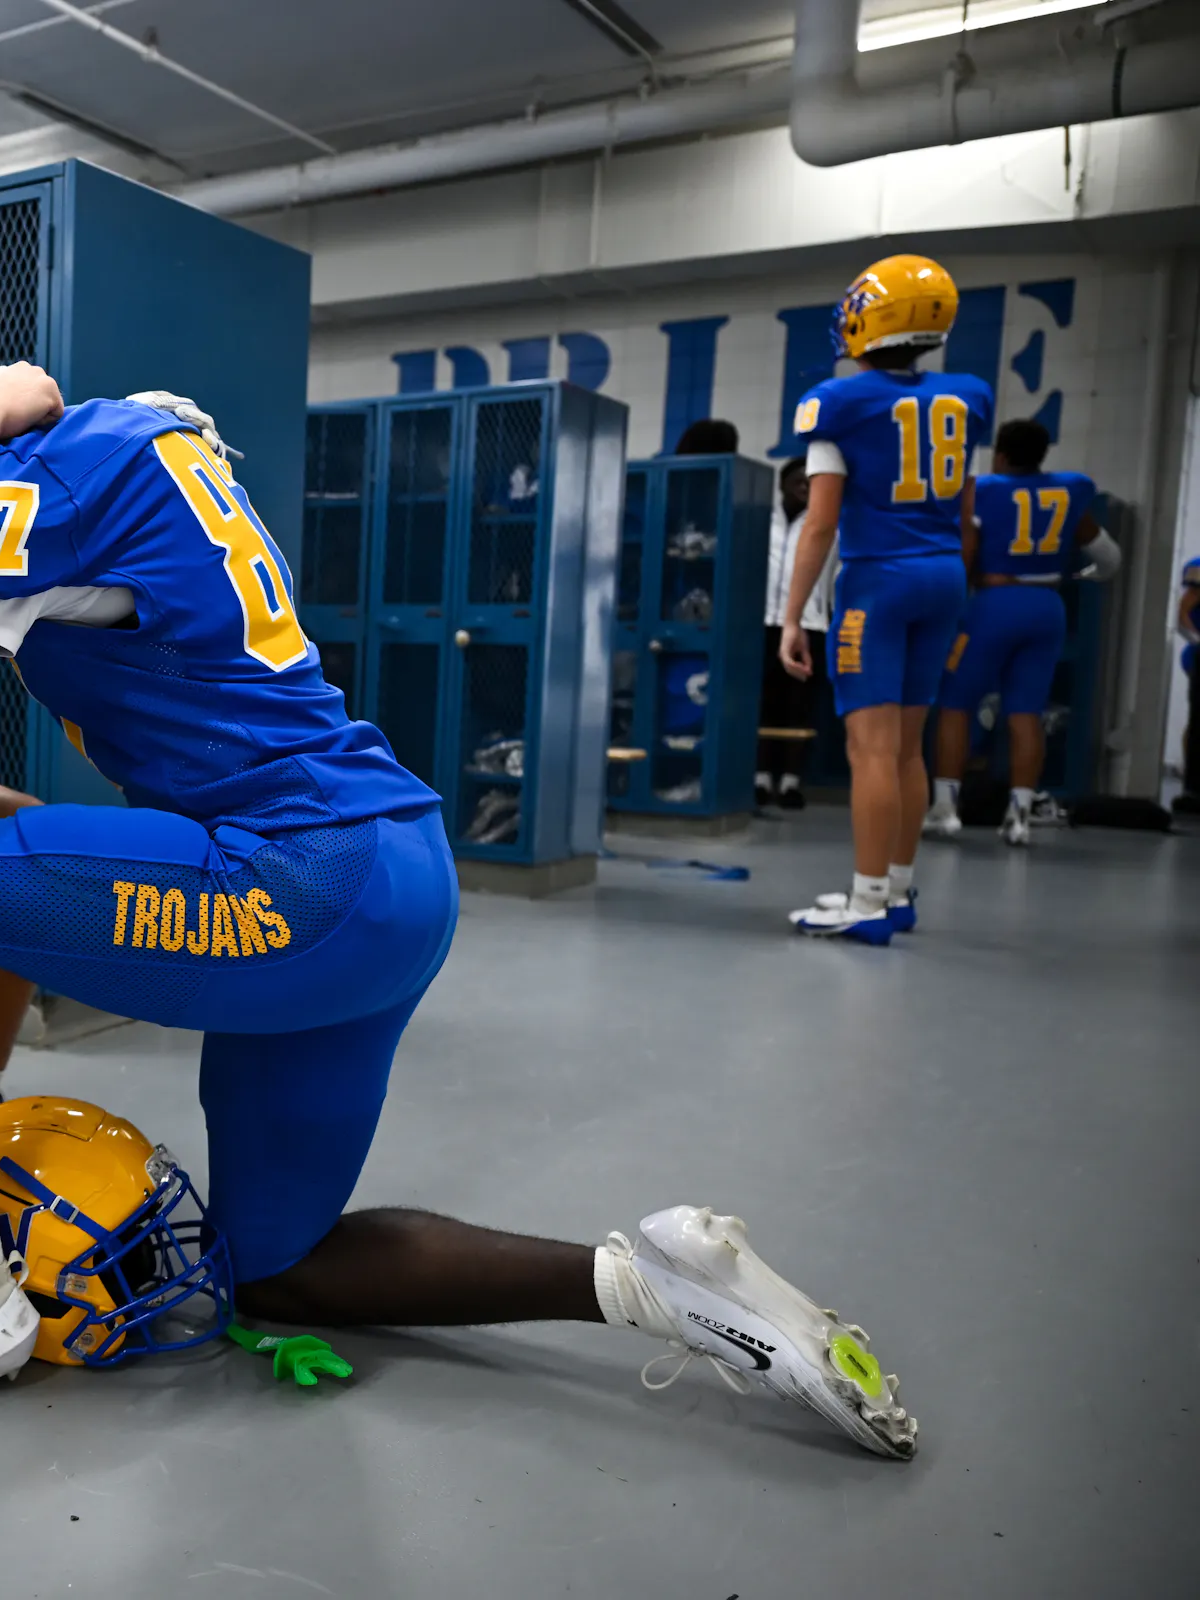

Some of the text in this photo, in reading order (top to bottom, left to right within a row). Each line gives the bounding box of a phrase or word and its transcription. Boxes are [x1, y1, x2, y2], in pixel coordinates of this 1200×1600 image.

[891, 394, 969, 504] 18
[1008, 486, 1070, 556] 17
[112, 880, 292, 958] TROJANS
[687, 1311, 777, 1353] AIR ZOOM
